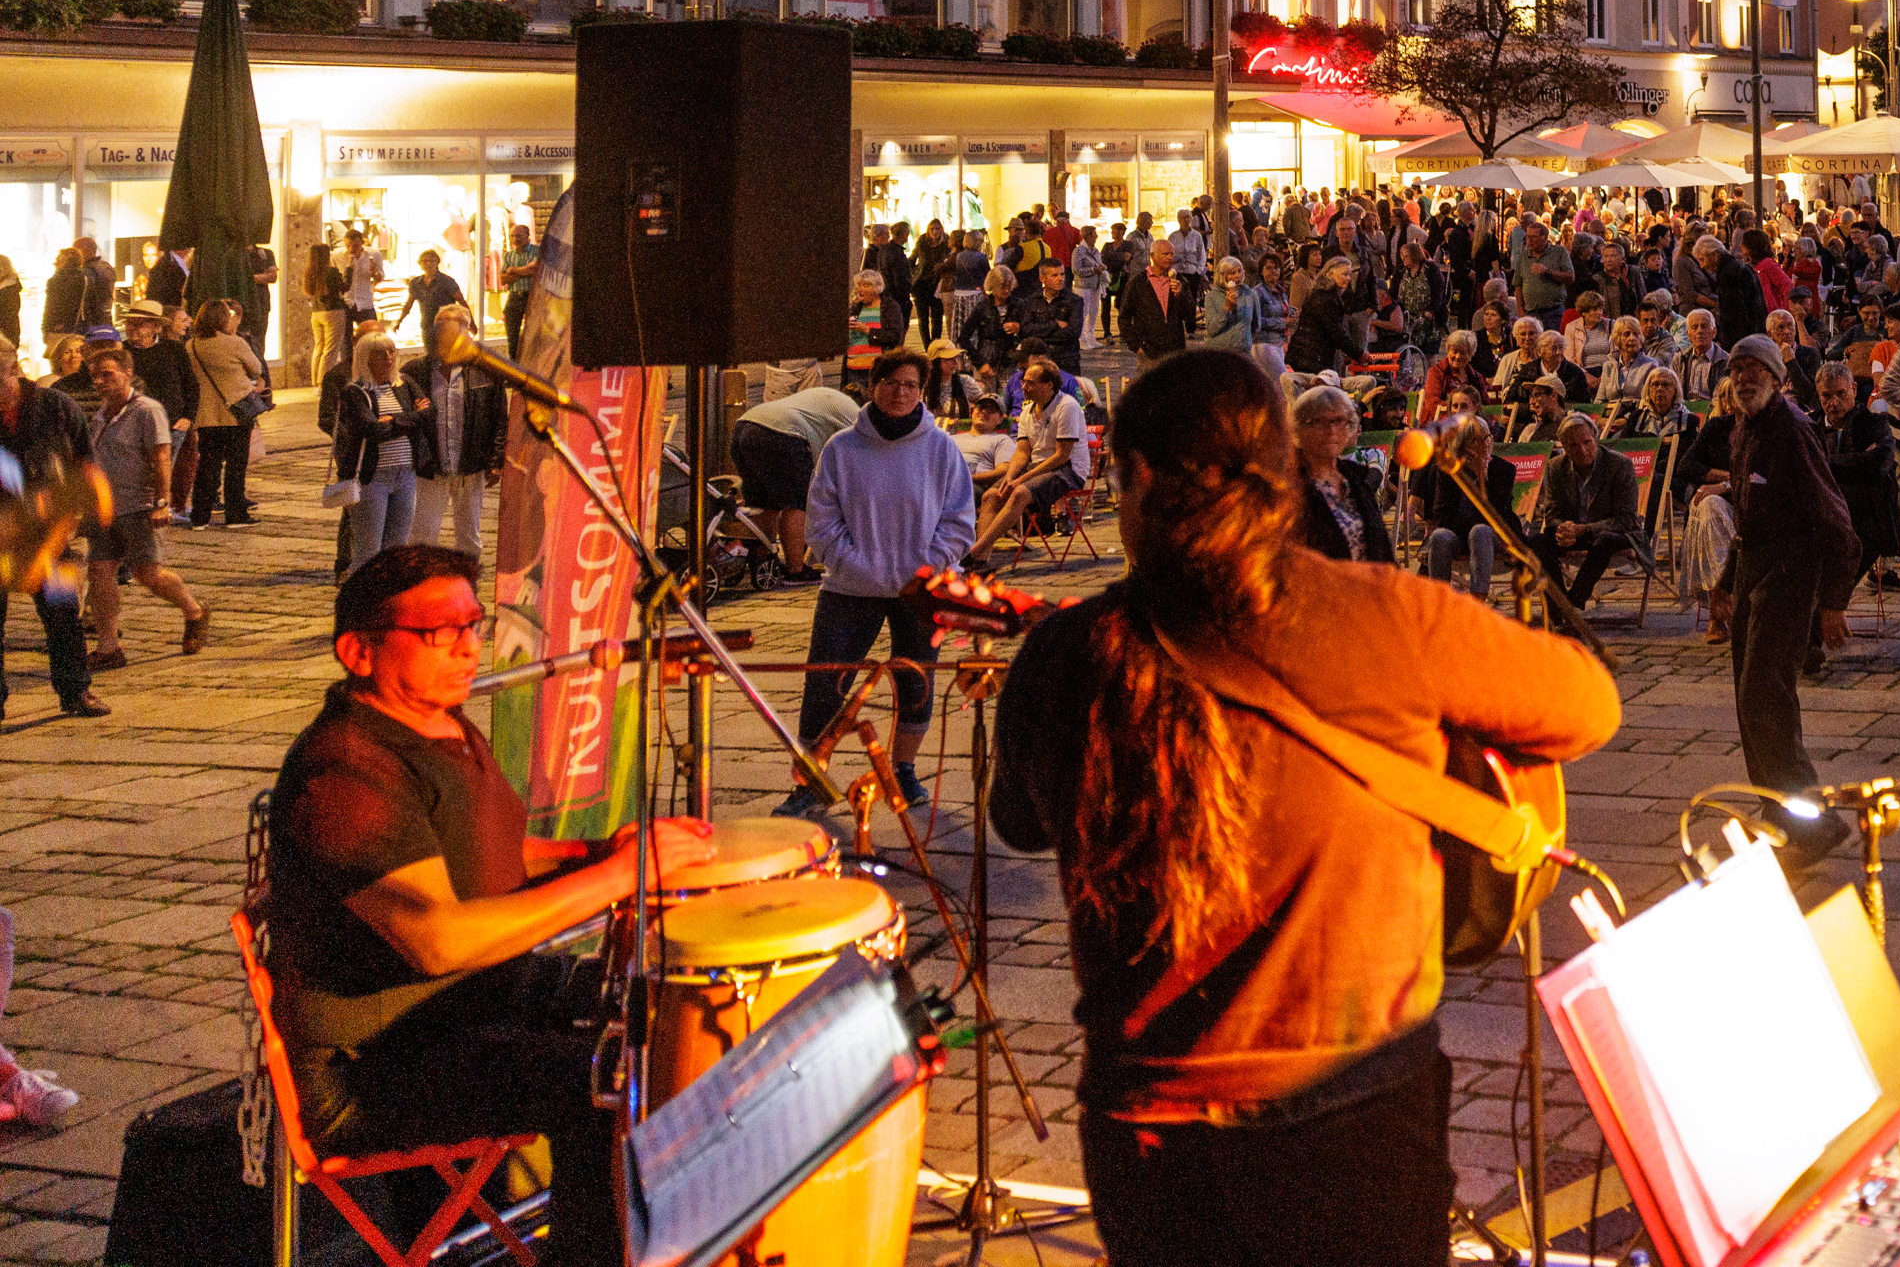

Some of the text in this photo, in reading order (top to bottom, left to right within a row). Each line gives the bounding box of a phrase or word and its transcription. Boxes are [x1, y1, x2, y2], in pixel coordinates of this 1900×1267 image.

[135, 147, 146, 162] &
[339, 145, 435, 160] STRUMPFERIE
[524, 145, 532, 158] &
[1406, 160, 1471, 170] CORTINA
[1802, 159, 1882, 171] CORTINA
